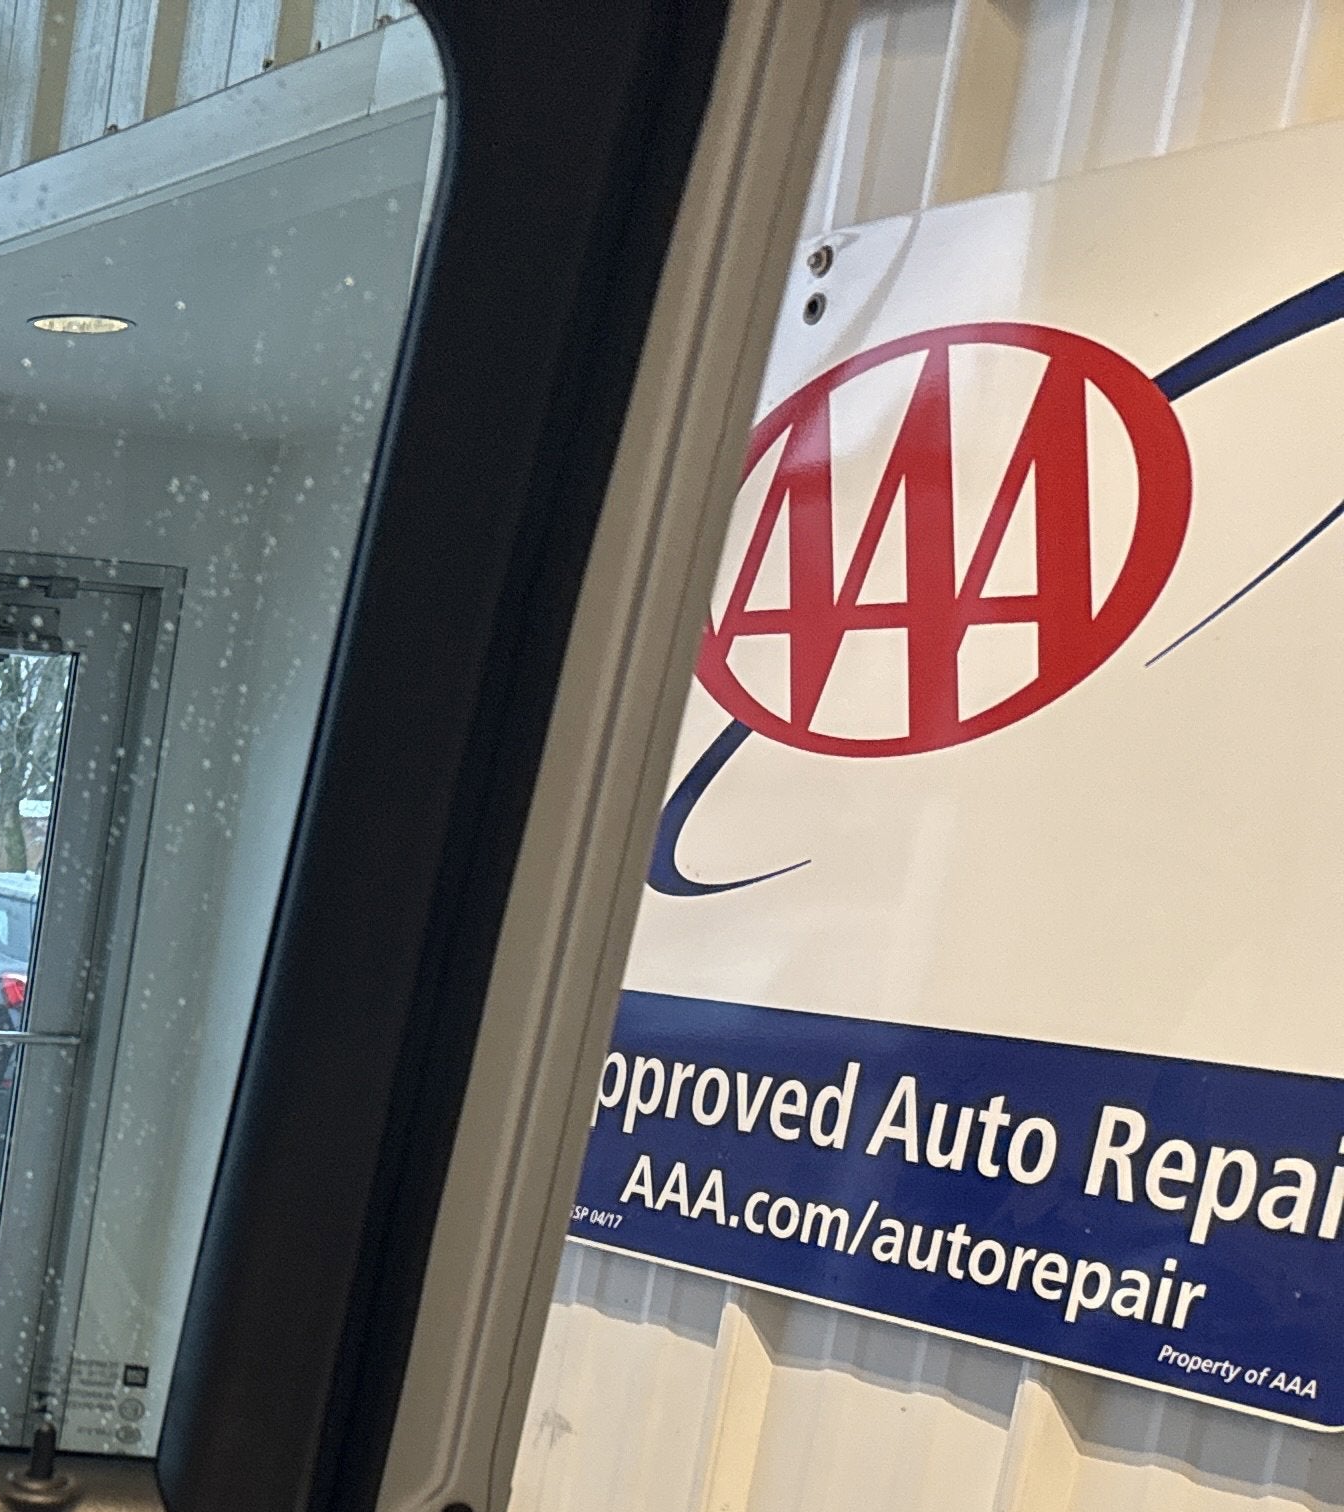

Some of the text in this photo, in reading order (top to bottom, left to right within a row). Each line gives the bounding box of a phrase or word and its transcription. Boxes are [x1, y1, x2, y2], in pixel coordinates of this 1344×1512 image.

[704, 330, 1112, 748] AAA
[569, 1205, 623, 1229] SP 04/17
[589, 1051, 1344, 1245] pproved Auto Repai
[619, 1154, 1207, 1330] AAA.com/autorepair
[1157, 1344, 1318, 1400] Property of AAA
